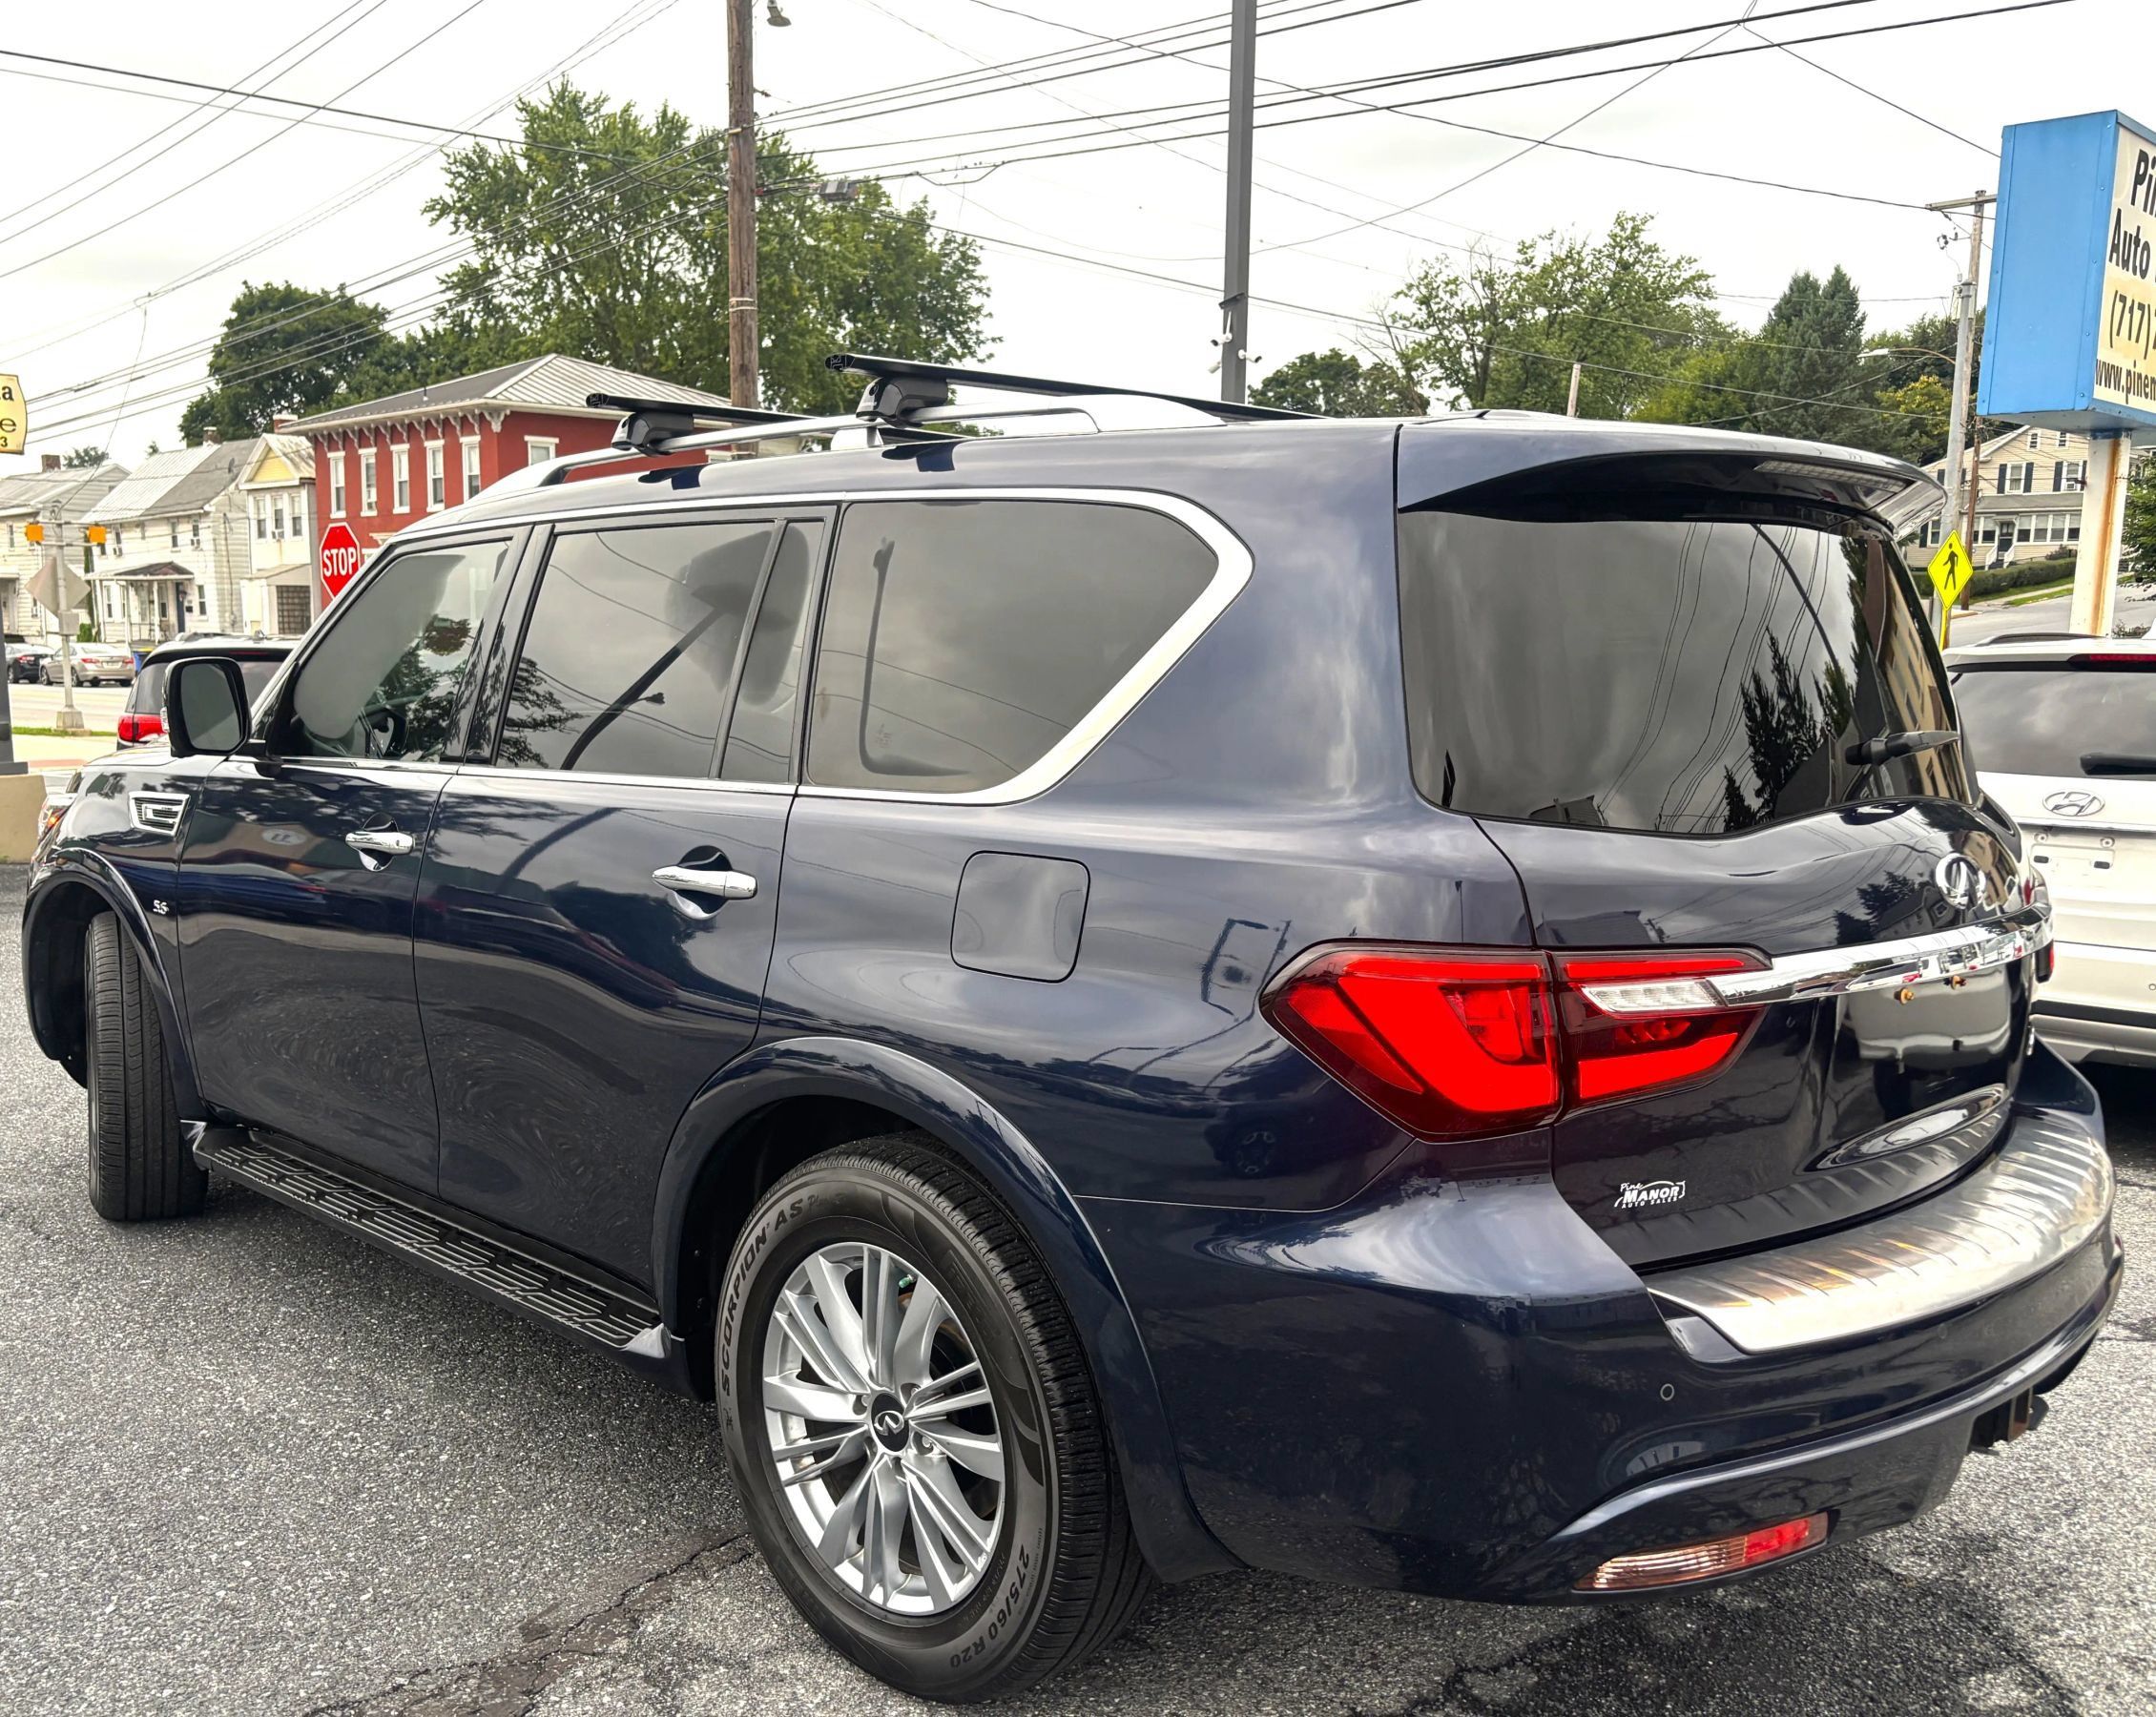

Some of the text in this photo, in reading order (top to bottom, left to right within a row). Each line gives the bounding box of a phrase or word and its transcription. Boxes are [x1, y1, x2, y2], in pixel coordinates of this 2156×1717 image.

[2108, 208, 2150, 279] Auto
[2109, 290, 2156, 360] (717)
[0, 385, 14, 401] a
[322, 547, 357, 577] STOP
[1621, 1194, 1678, 1210] AUTO SALES
[1622, 1186, 1680, 1204] MANOR
[721, 1226, 767, 1396] SCORPION
[774, 1198, 803, 1231] AS
[987, 1543, 1029, 1641] 275/60
[950, 1635, 986, 1668] R20
